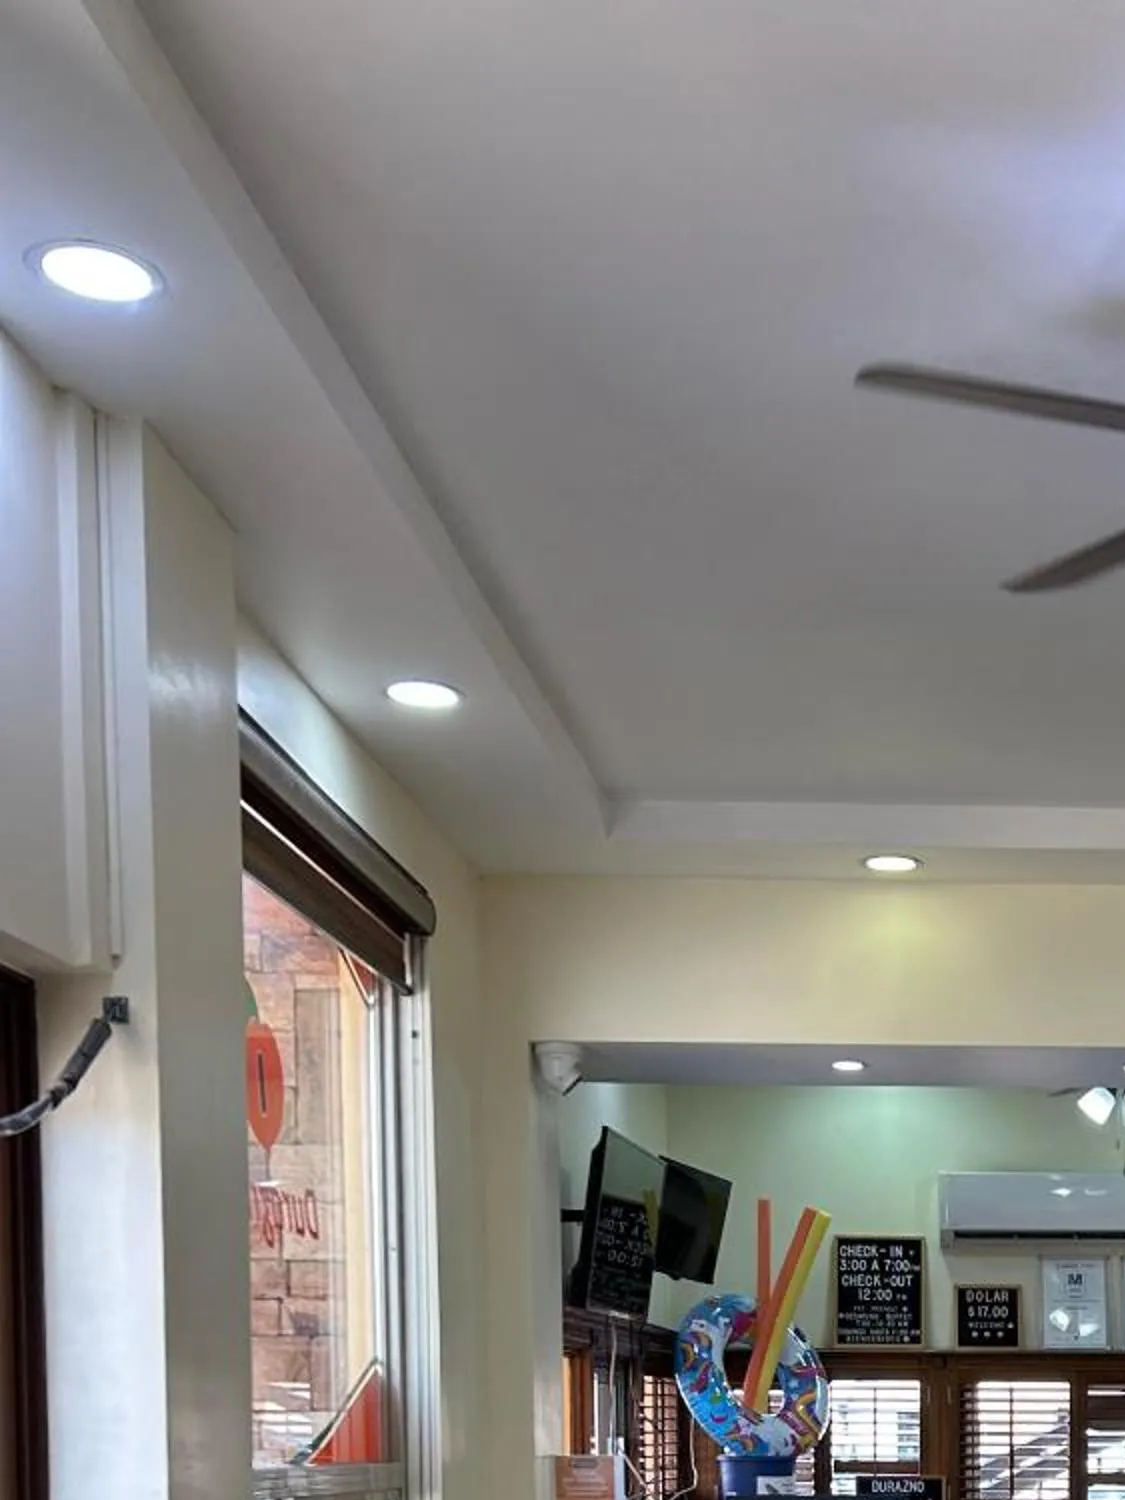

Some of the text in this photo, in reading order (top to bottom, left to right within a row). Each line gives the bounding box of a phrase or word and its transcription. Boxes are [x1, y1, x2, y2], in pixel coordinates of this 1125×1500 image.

[871, 1260, 880, 1271] A
[965, 1289, 1009, 1303] DOLAR
[871, 1480, 925, 1493] DURAZNO
